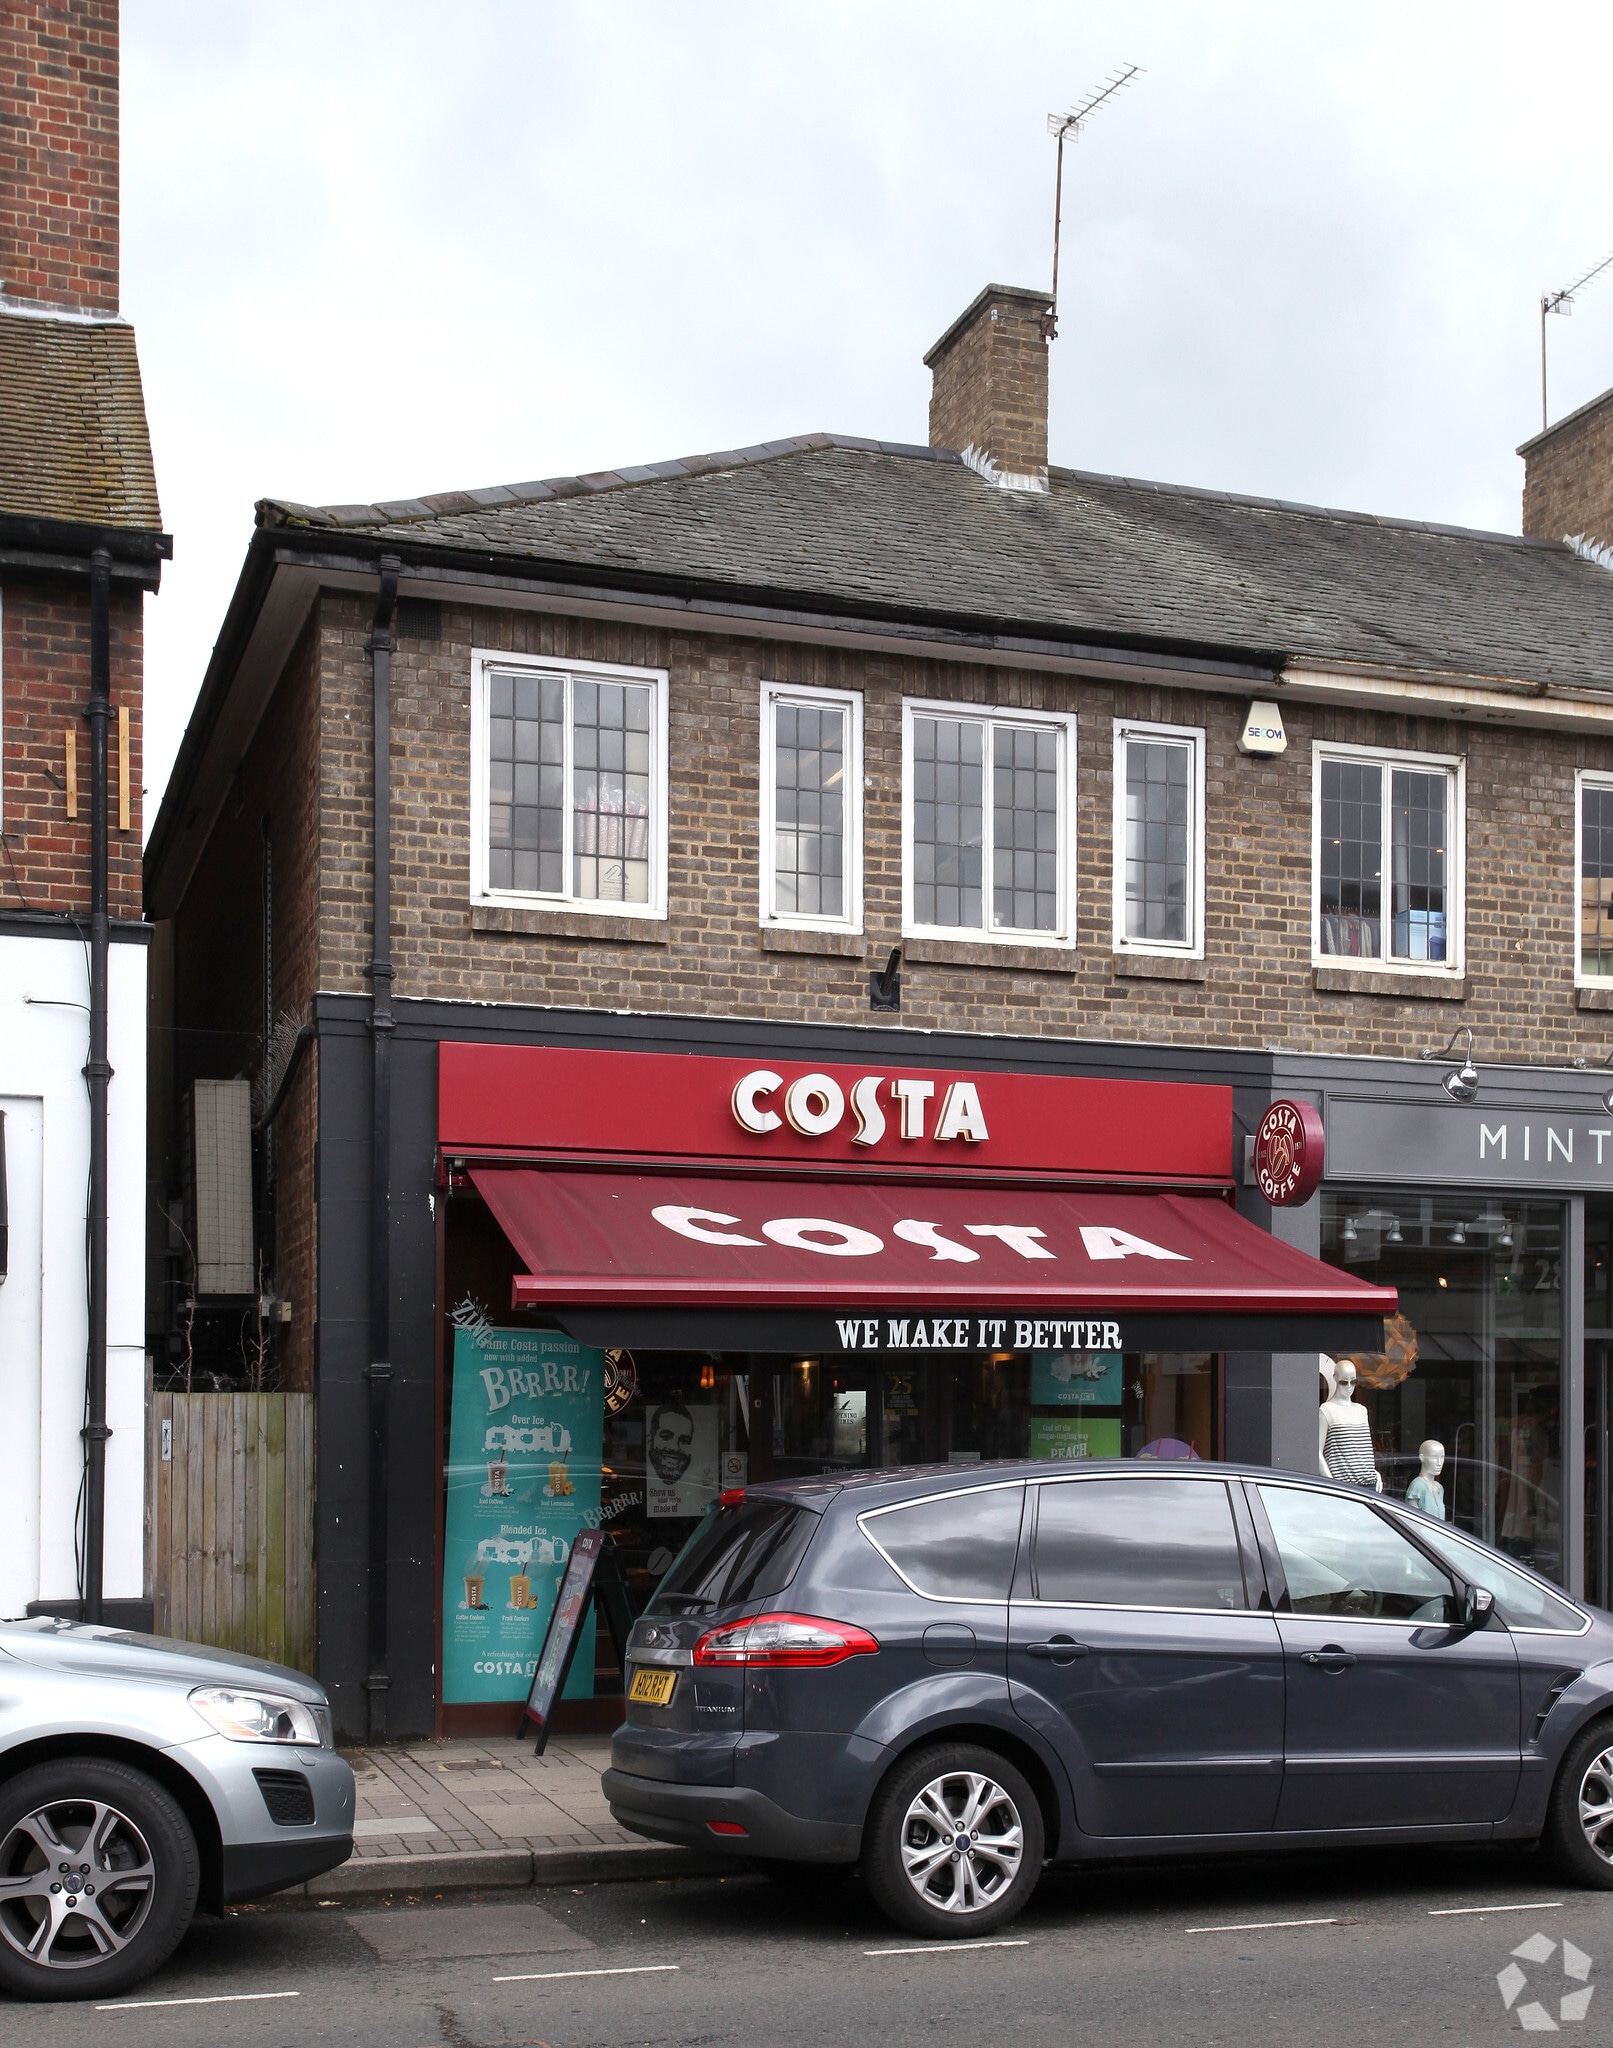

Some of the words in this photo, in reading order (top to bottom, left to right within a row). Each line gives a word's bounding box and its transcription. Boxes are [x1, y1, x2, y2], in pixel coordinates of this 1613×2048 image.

[1248, 727, 1282, 739] SECOM
[731, 1070, 990, 1147] COSTA
[1263, 1109, 1296, 1140] COSTA
[1480, 1123, 1612, 1164] MINT
[1260, 1161, 1301, 1199] COFFEE
[651, 1205, 1193, 1263] COSTA
[451, 1298, 496, 1349] ZING
[836, 1319, 879, 1348] WE
[887, 1319, 970, 1348] MAKE
[976, 1319, 1006, 1348] IT
[1014, 1320, 1123, 1350] BETTER
[510, 1338, 538, 1351] Costa
[541, 1341, 580, 1354] passion
[500, 1354, 515, 1362] with
[517, 1355, 538, 1363] added
[479, 1362, 591, 1416] BRRRR!
[1057, 1393, 1080, 1401] COSTA
[512, 1414, 530, 1424] Over
[532, 1415, 545, 1425] Ice
[1051, 1443, 1087, 1458] PEACH
[650, 1488, 667, 1497] Show
[653, 1504, 671, 1513] made
[671, 1503, 678, 1512] of
[500, 1524, 533, 1535] Blended
[535, 1525, 547, 1535] Ice
[487, 1650, 515, 1659] refreshing
[473, 1661, 523, 1676] COSTA
[695, 1705, 736, 1713] TITANIUM
